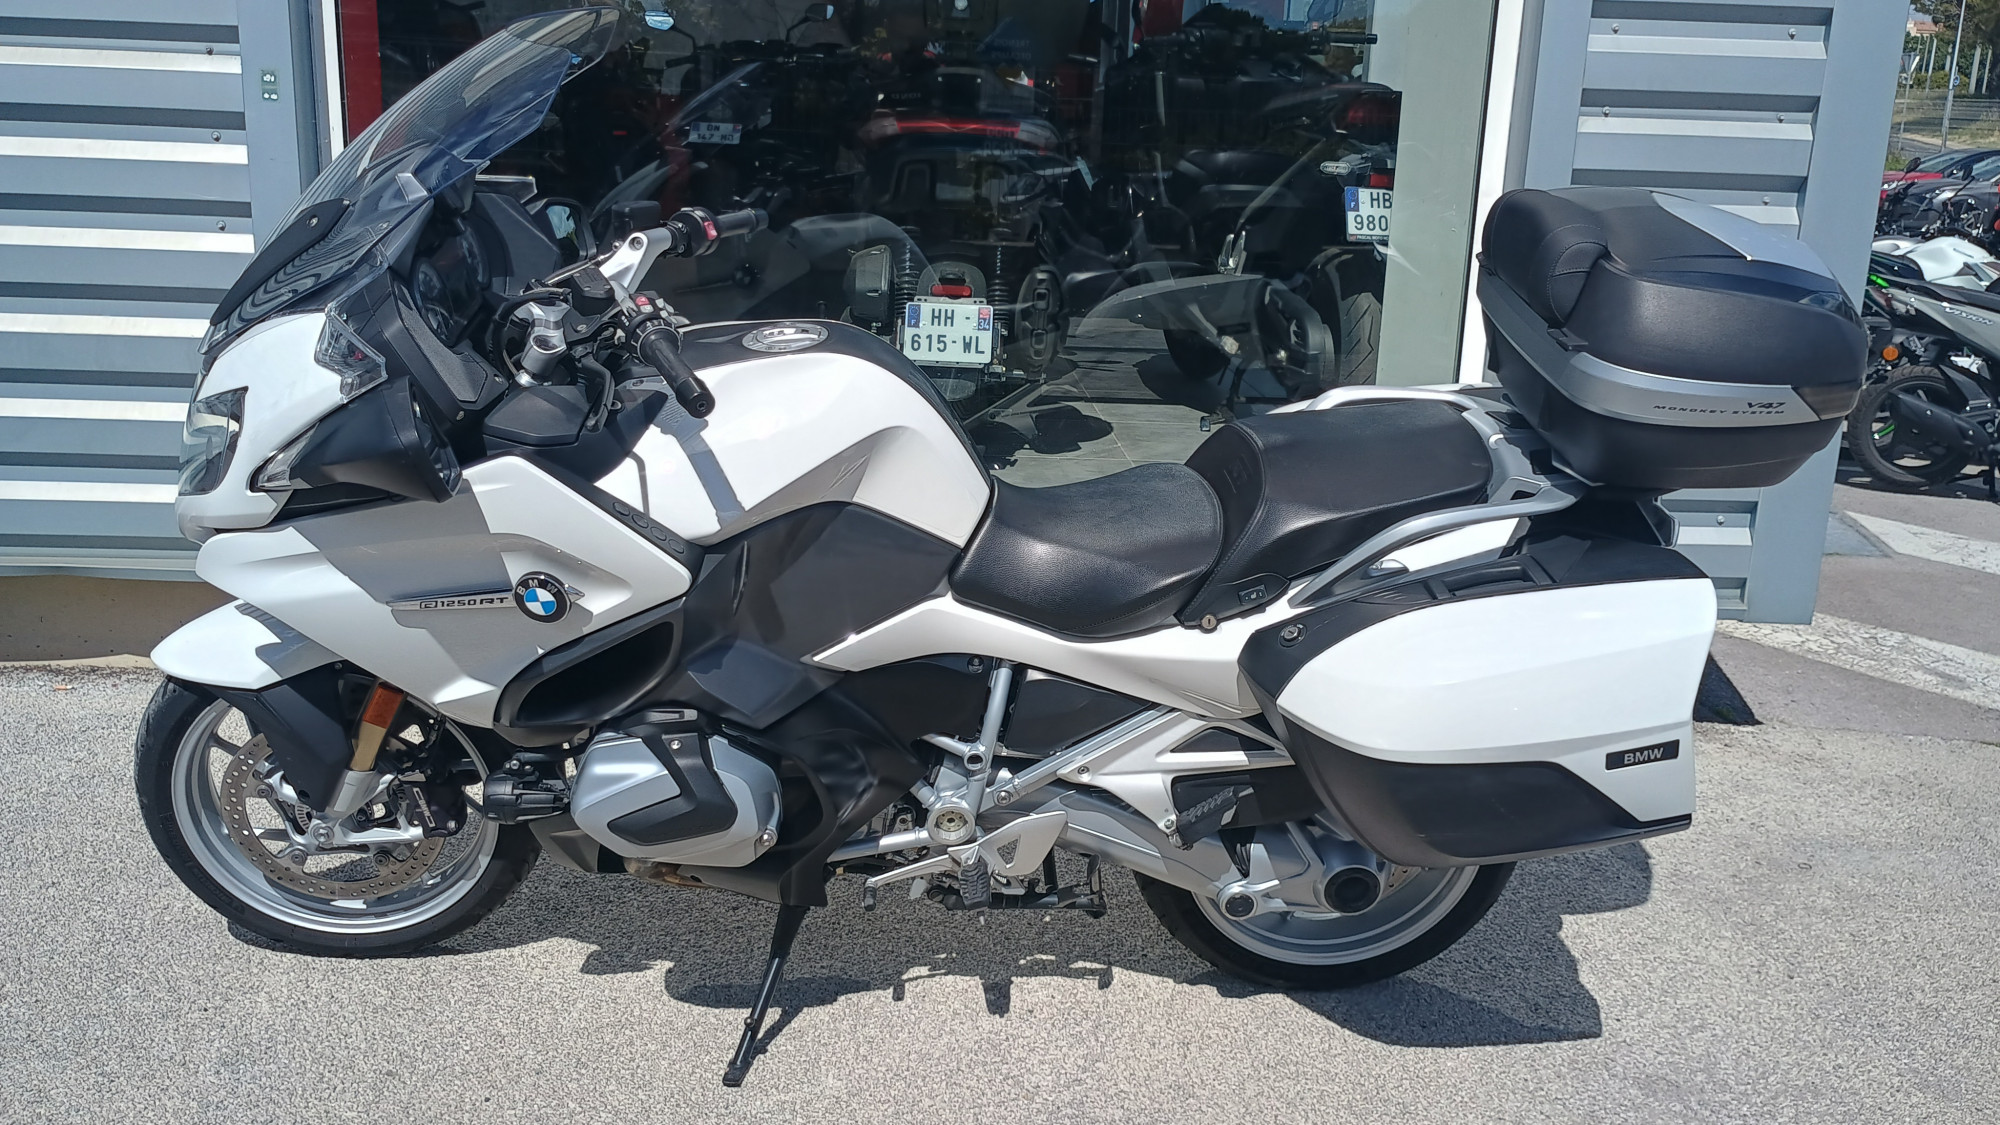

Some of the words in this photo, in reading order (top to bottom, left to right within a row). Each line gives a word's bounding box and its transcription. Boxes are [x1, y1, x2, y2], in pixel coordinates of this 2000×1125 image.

[1370, 192, 1393, 209] HB
[1354, 214, 1388, 231] 980
[978, 319, 990, 329] 34
[1945, 308, 1994, 325] VISION
[1653, 405, 1727, 413] MONOKEY
[516, 579, 557, 596] BMW
[1624, 747, 1664, 765] BMW
